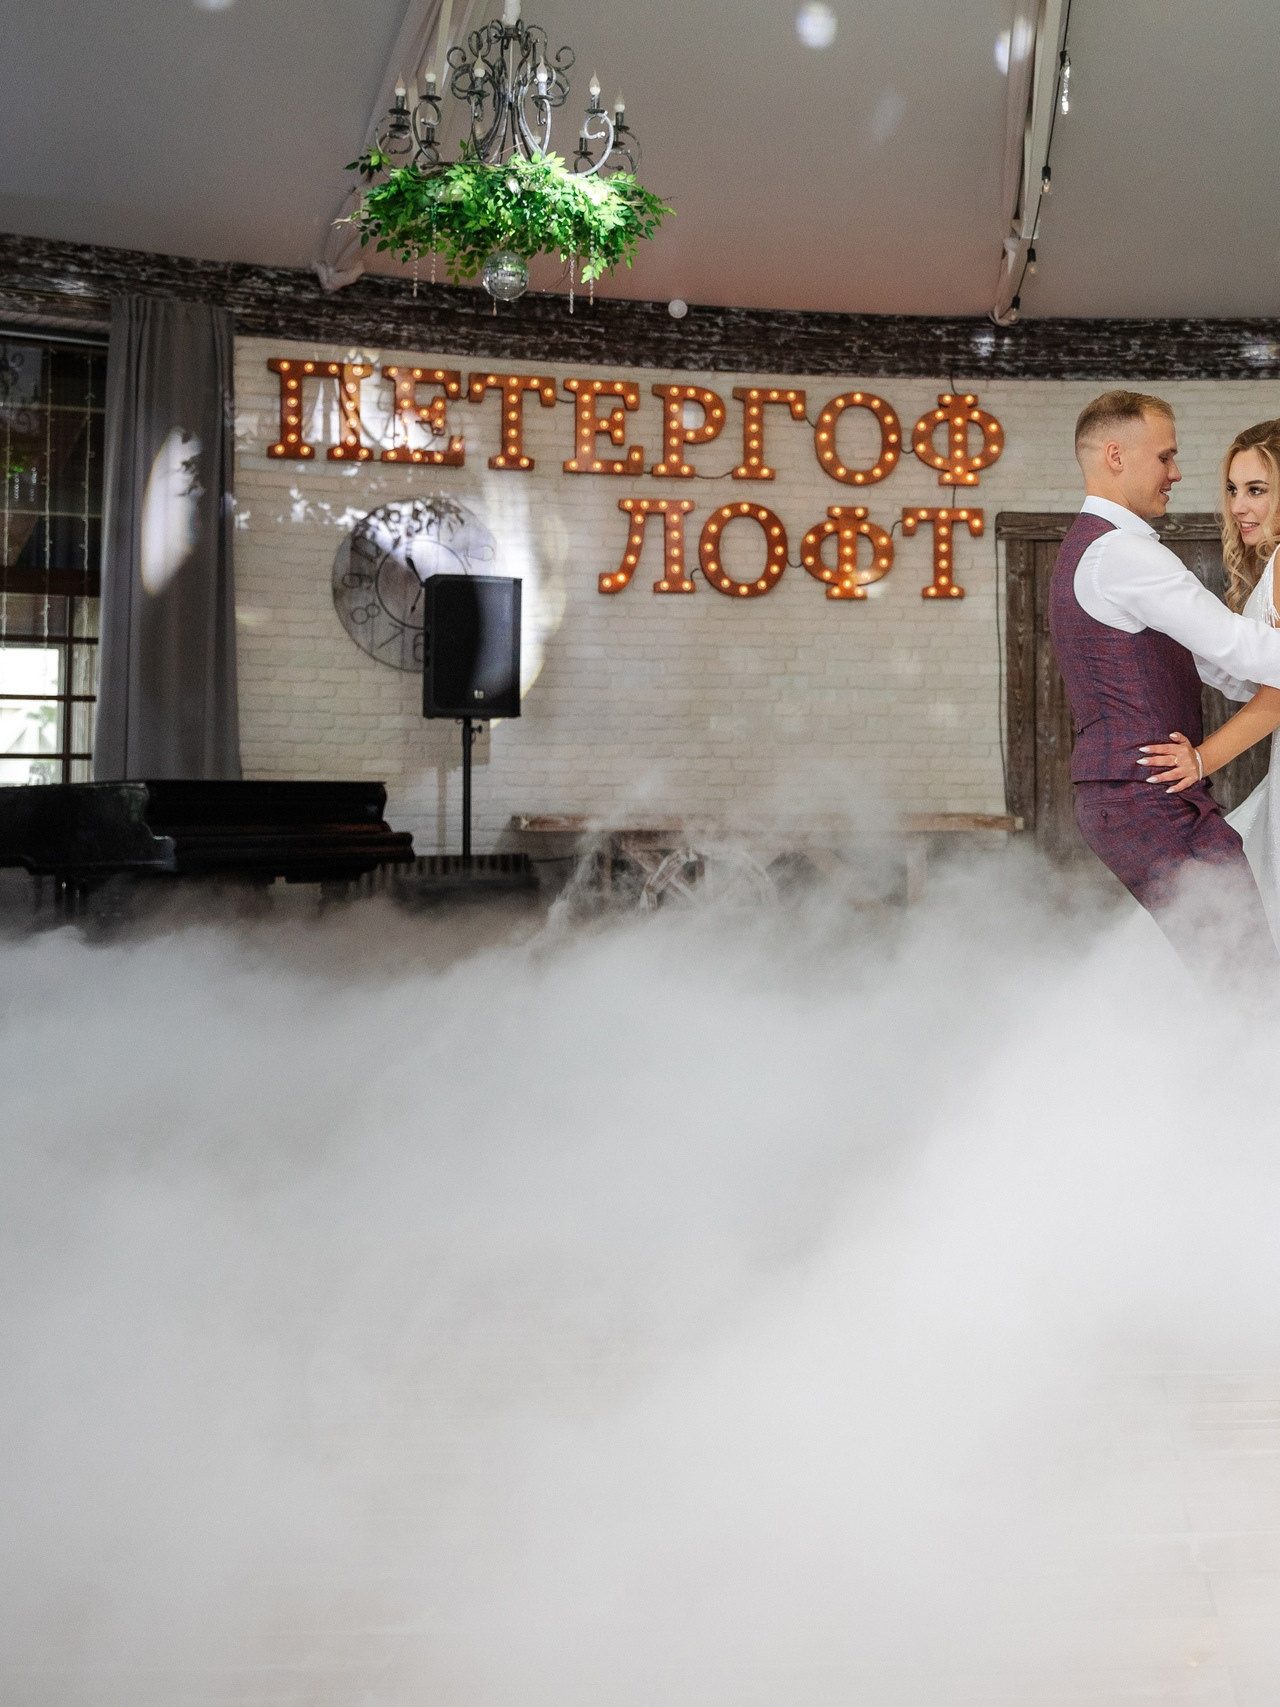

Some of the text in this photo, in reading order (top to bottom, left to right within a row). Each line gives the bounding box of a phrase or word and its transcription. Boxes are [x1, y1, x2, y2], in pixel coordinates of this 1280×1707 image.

[267, 357, 1005, 486] ПЕТЕРГОФ
[598, 498, 985, 600] ЛОФТ
[351, 602, 381, 626] 8
